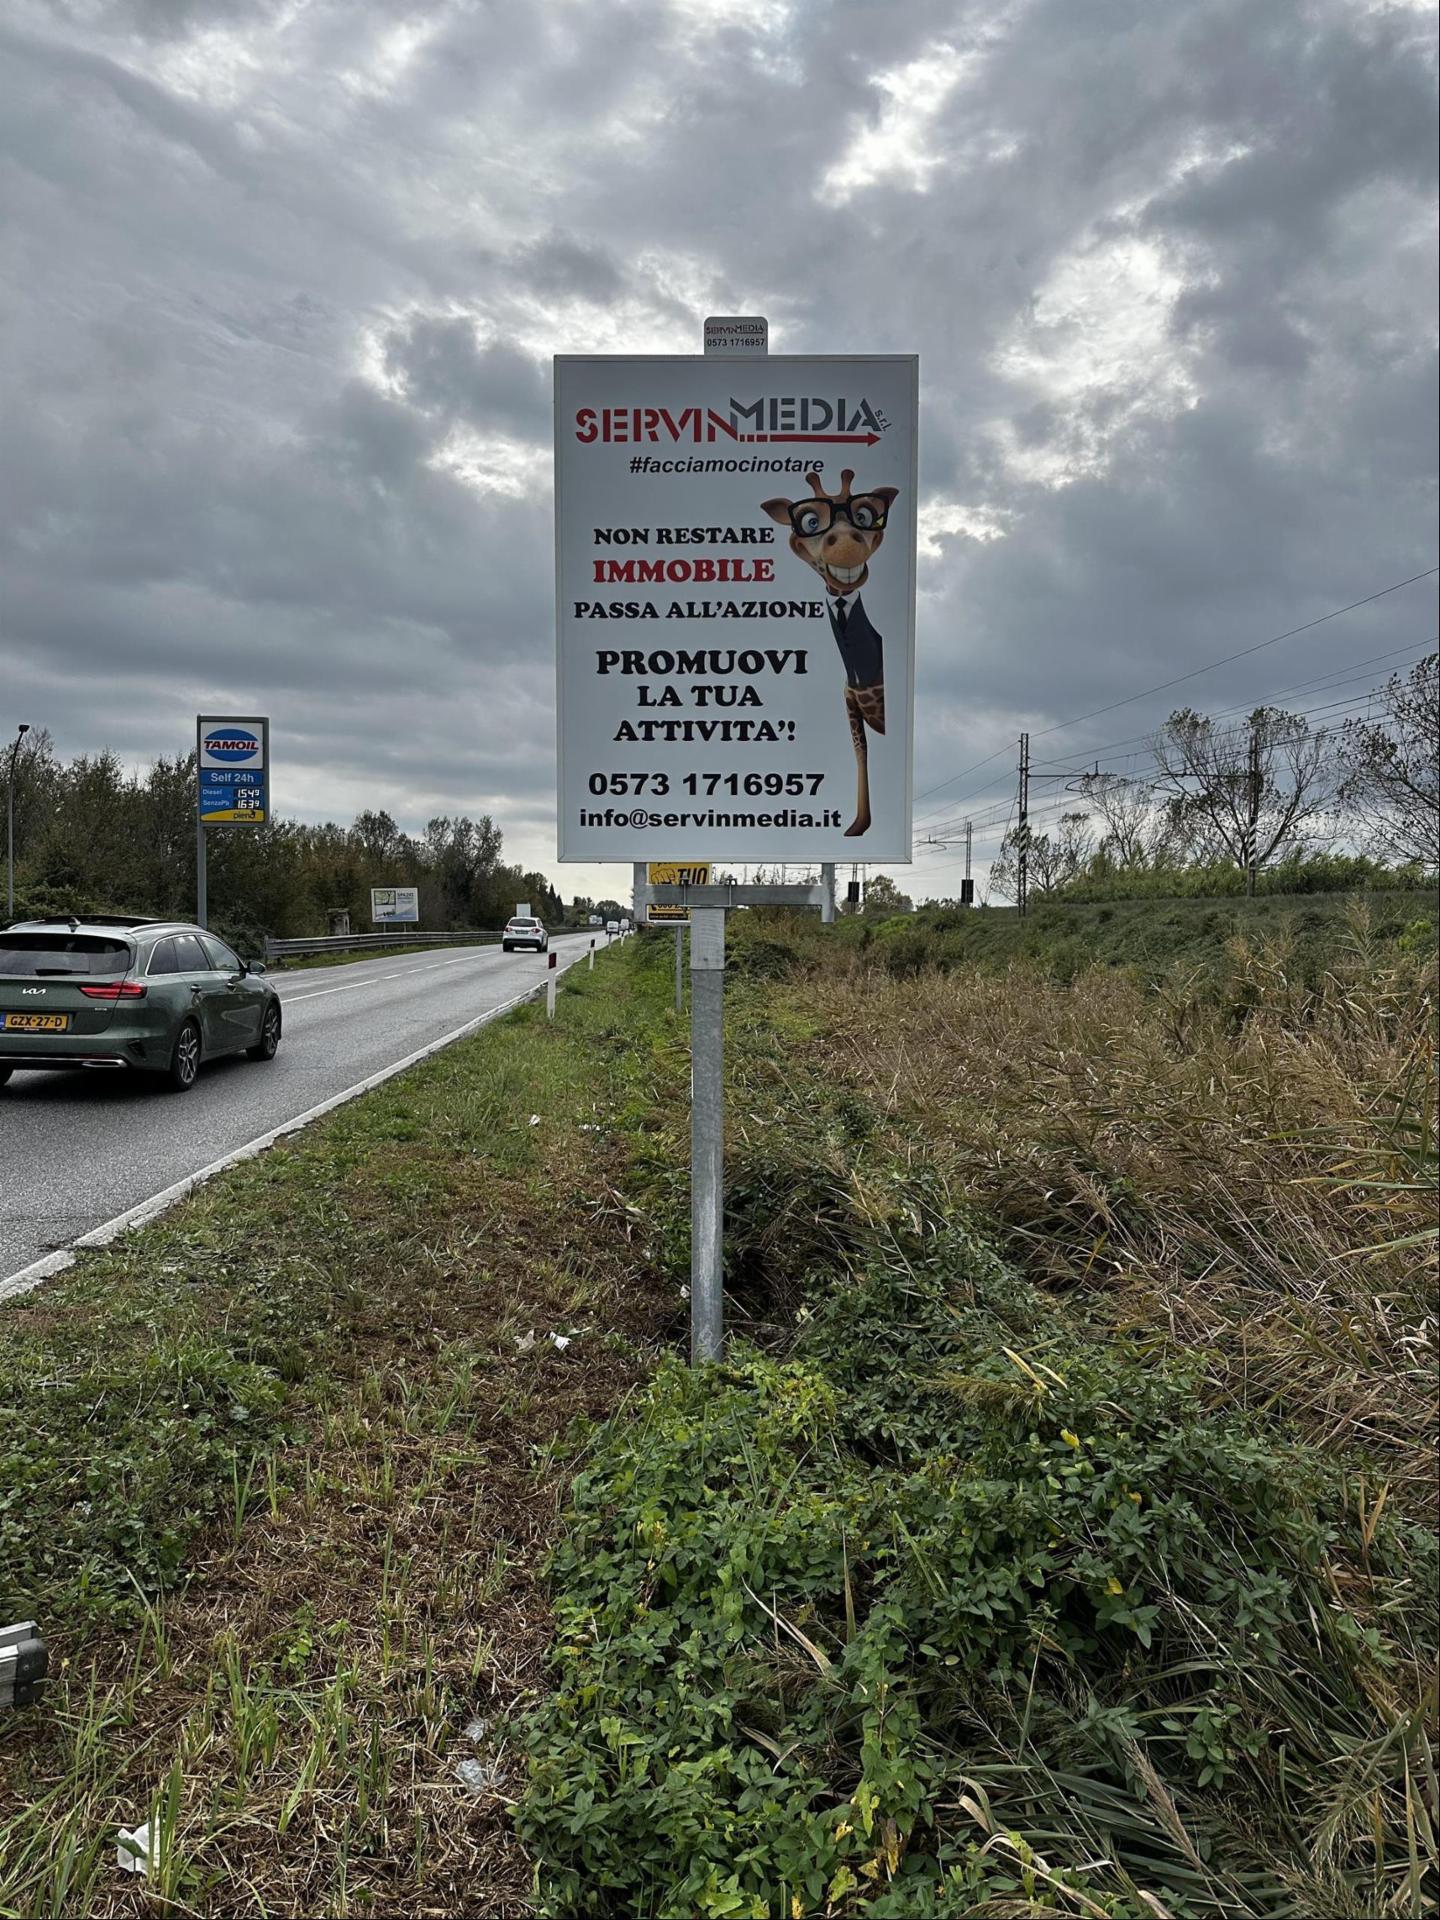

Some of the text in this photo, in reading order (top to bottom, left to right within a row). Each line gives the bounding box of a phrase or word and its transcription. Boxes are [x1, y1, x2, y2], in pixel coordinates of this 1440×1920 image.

[707, 338, 764, 346] 0573 1716957
[629, 456, 824, 473] #facciamocinotare
[594, 527, 774, 545] NON RESTARE
[593, 559, 775, 583] IMMOBILE
[574, 601, 824, 619] PASSA ALL'AZIONE
[596, 650, 808, 675] PROMUOVI
[637, 686, 763, 707] LA TUA
[203, 741, 259, 750] TAMOIL
[211, 773, 254, 783] Self 24h
[588, 773, 825, 796] 0573 1716957
[580, 808, 842, 829] info@servinmedia.it
[10, 1016, 63, 1027] GZX-27-D
